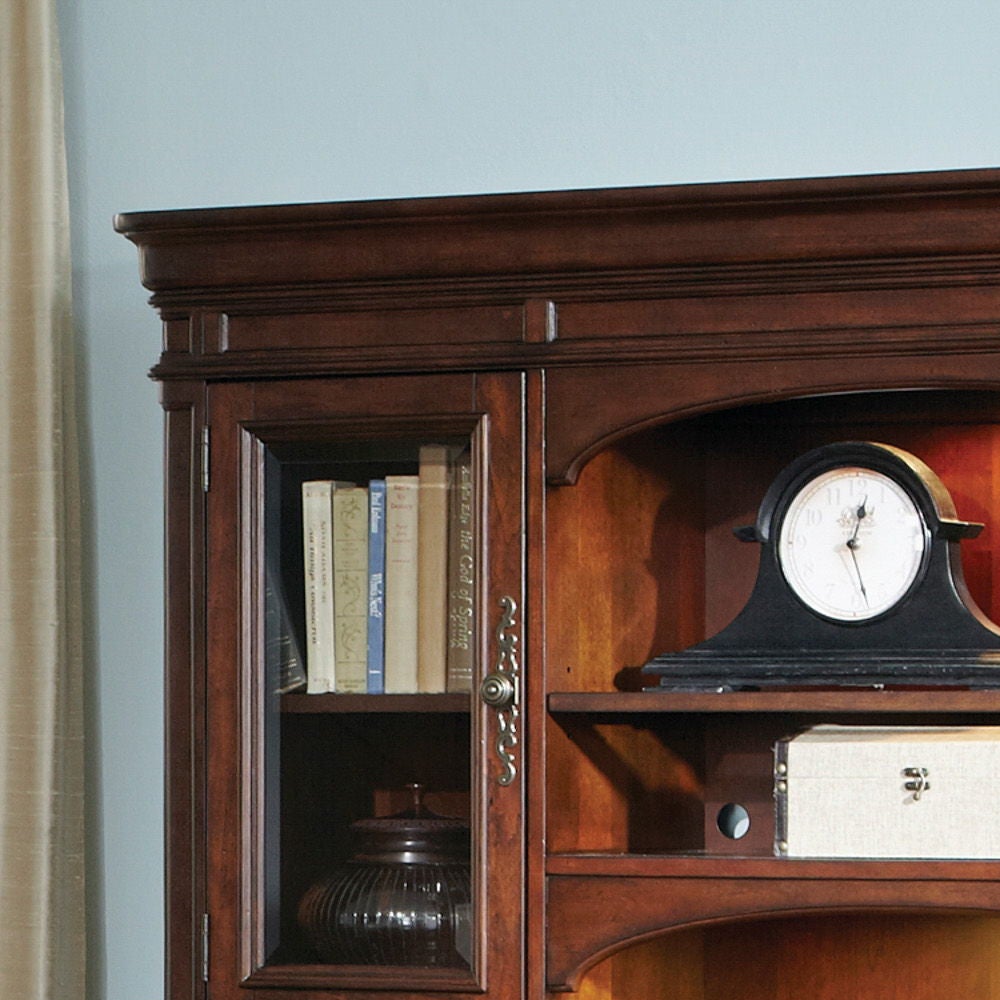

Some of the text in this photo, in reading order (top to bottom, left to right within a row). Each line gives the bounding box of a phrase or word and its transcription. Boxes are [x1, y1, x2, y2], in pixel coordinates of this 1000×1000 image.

[457, 530, 473, 650] the God of Spring
